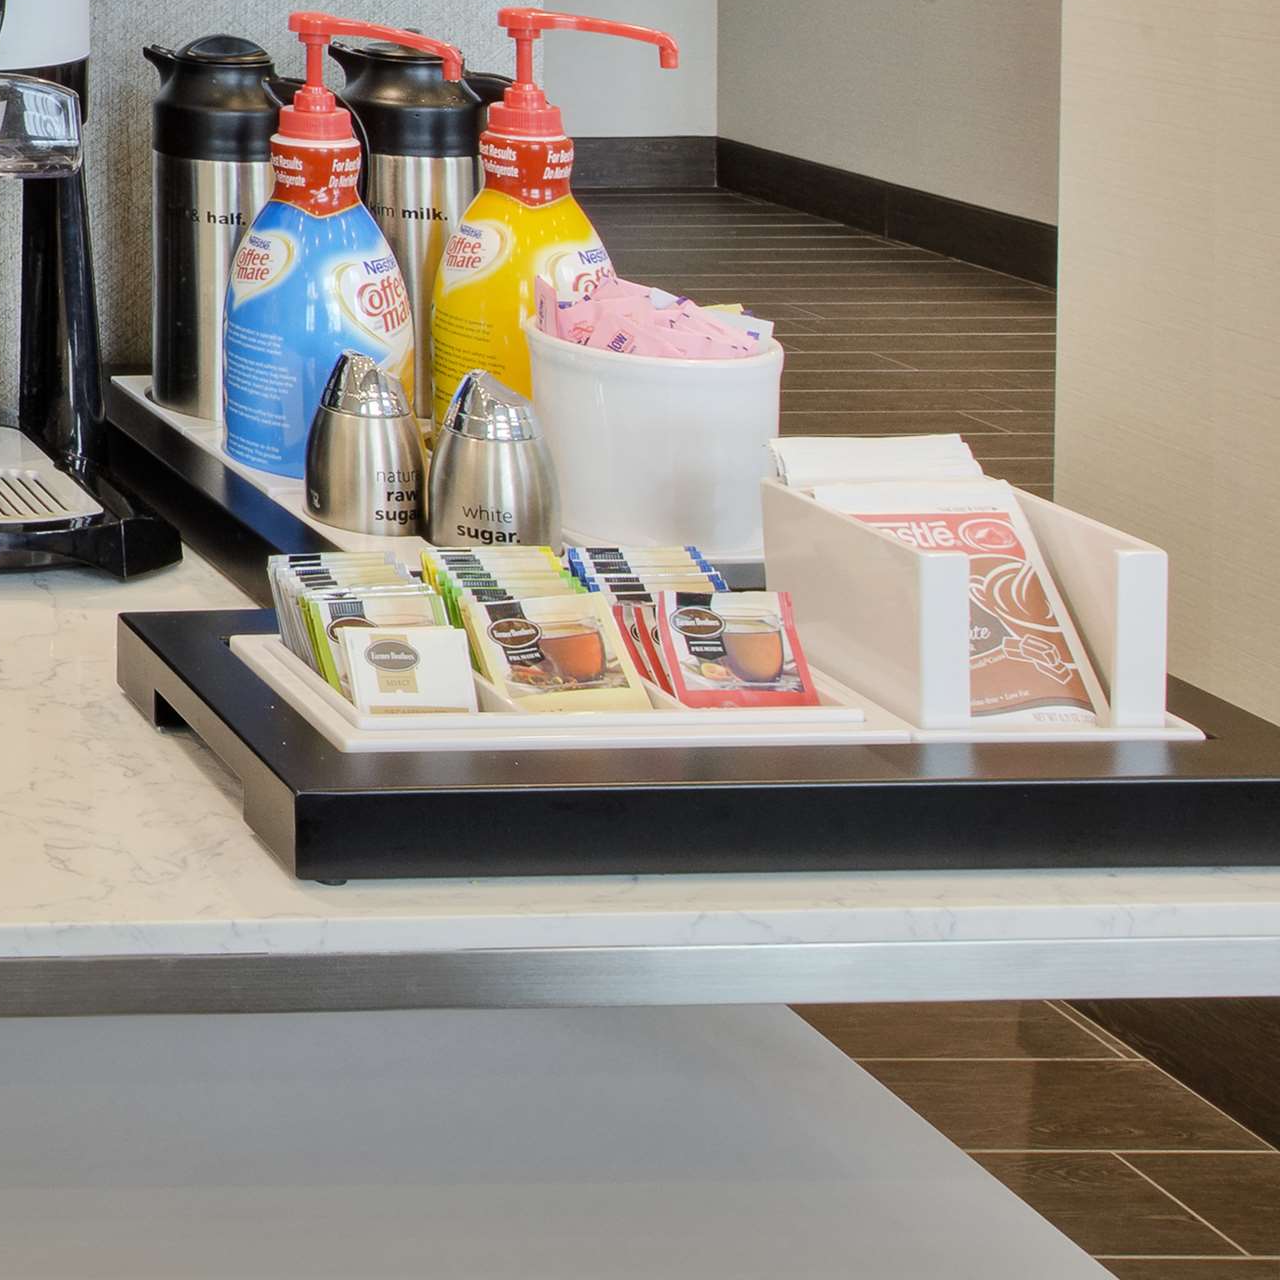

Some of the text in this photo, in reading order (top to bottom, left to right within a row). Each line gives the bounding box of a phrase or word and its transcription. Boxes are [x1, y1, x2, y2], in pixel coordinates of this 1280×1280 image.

[207, 211, 247, 226] half.
[369, 202, 448, 221] kim milk.
[446, 254, 481, 269] mate
[236, 266, 270, 281] mate
[375, 508, 418, 525] suga
[462, 505, 513, 524] white
[457, 524, 521, 544] sugar.
